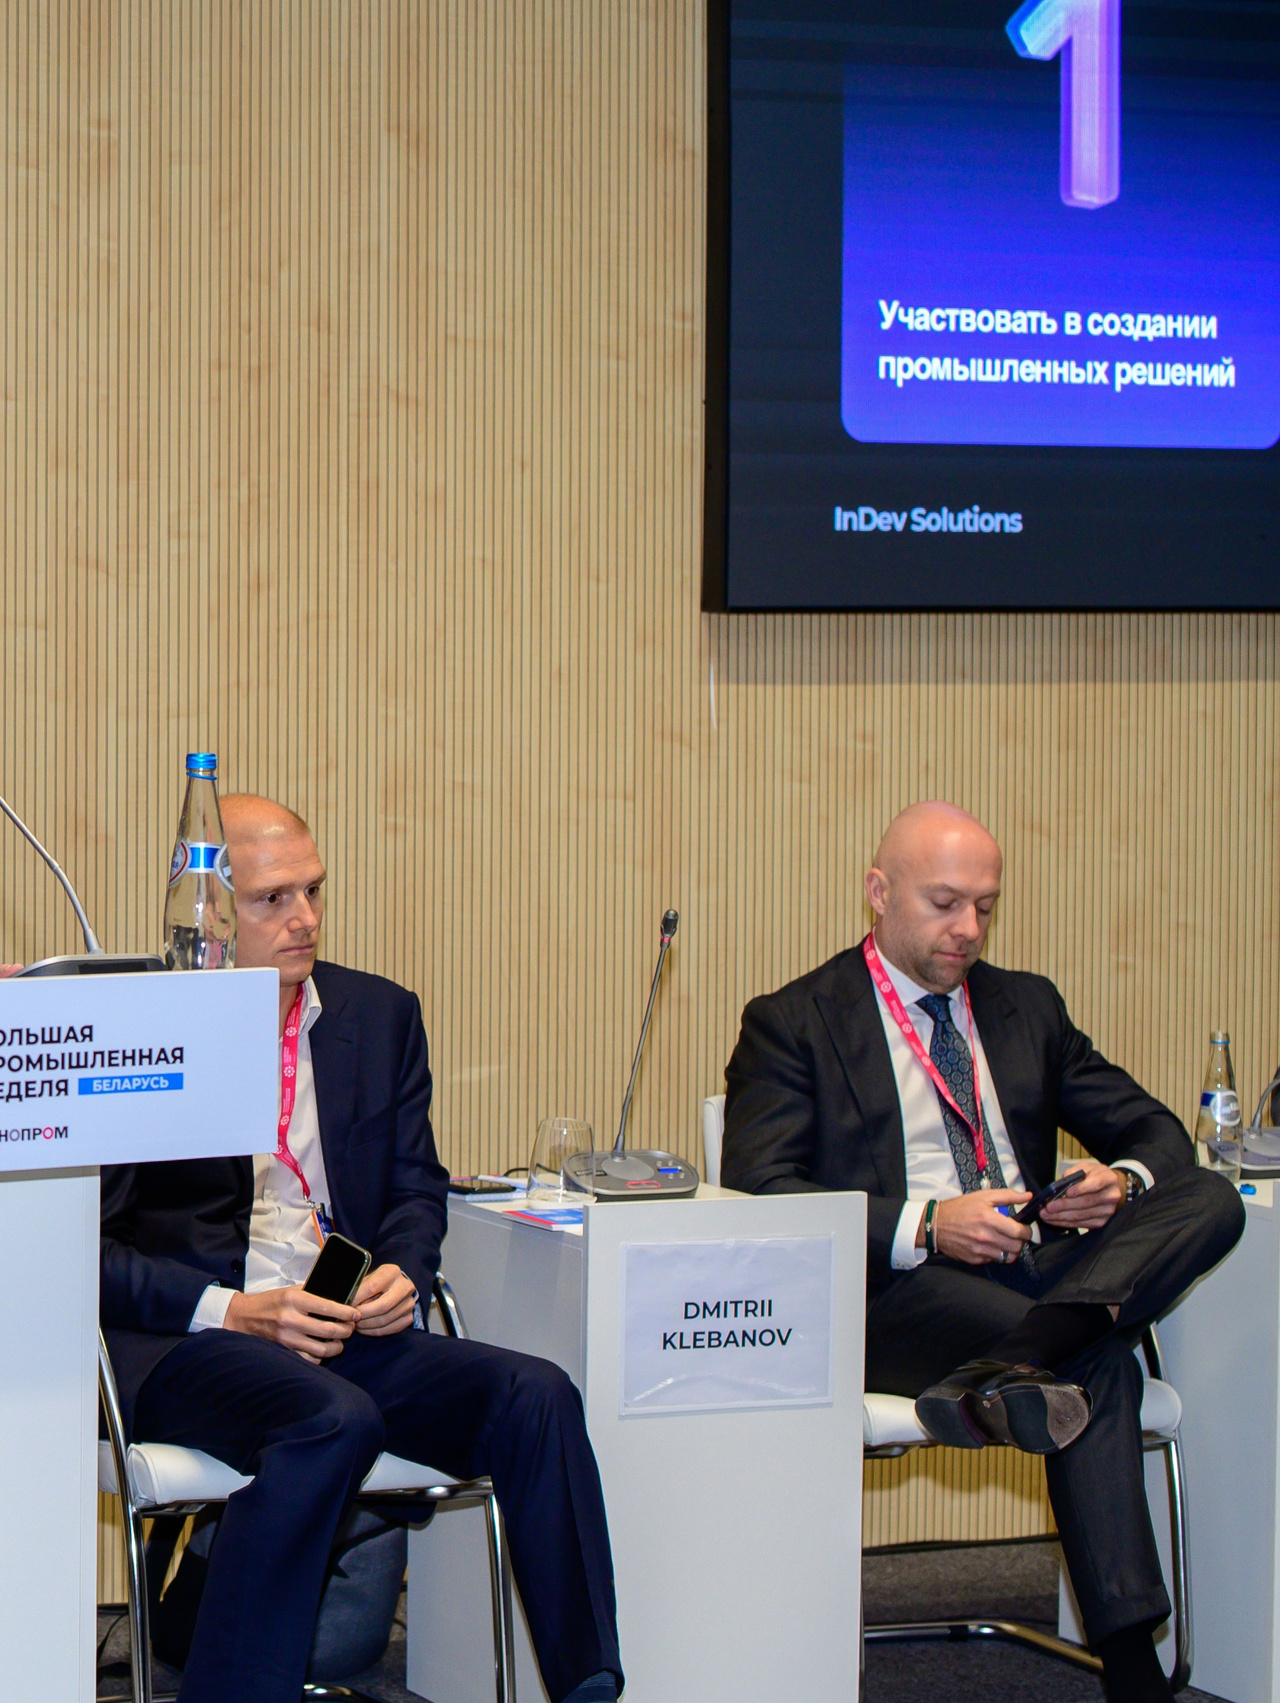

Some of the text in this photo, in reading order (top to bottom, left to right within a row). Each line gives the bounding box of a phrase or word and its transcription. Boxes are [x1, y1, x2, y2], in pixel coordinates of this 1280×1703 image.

[1006, 0, 1122, 210] 1
[878, 299, 1218, 342] Участвовать в создании
[878, 355, 1236, 393] промышленных решений
[833, 504, 1023, 534] InDev Solutions
[92, 1076, 170, 1092] БЕЛАРУСЬ
[683, 1299, 773, 1320] DMITRII
[662, 1327, 793, 1350] KLEBANOV
